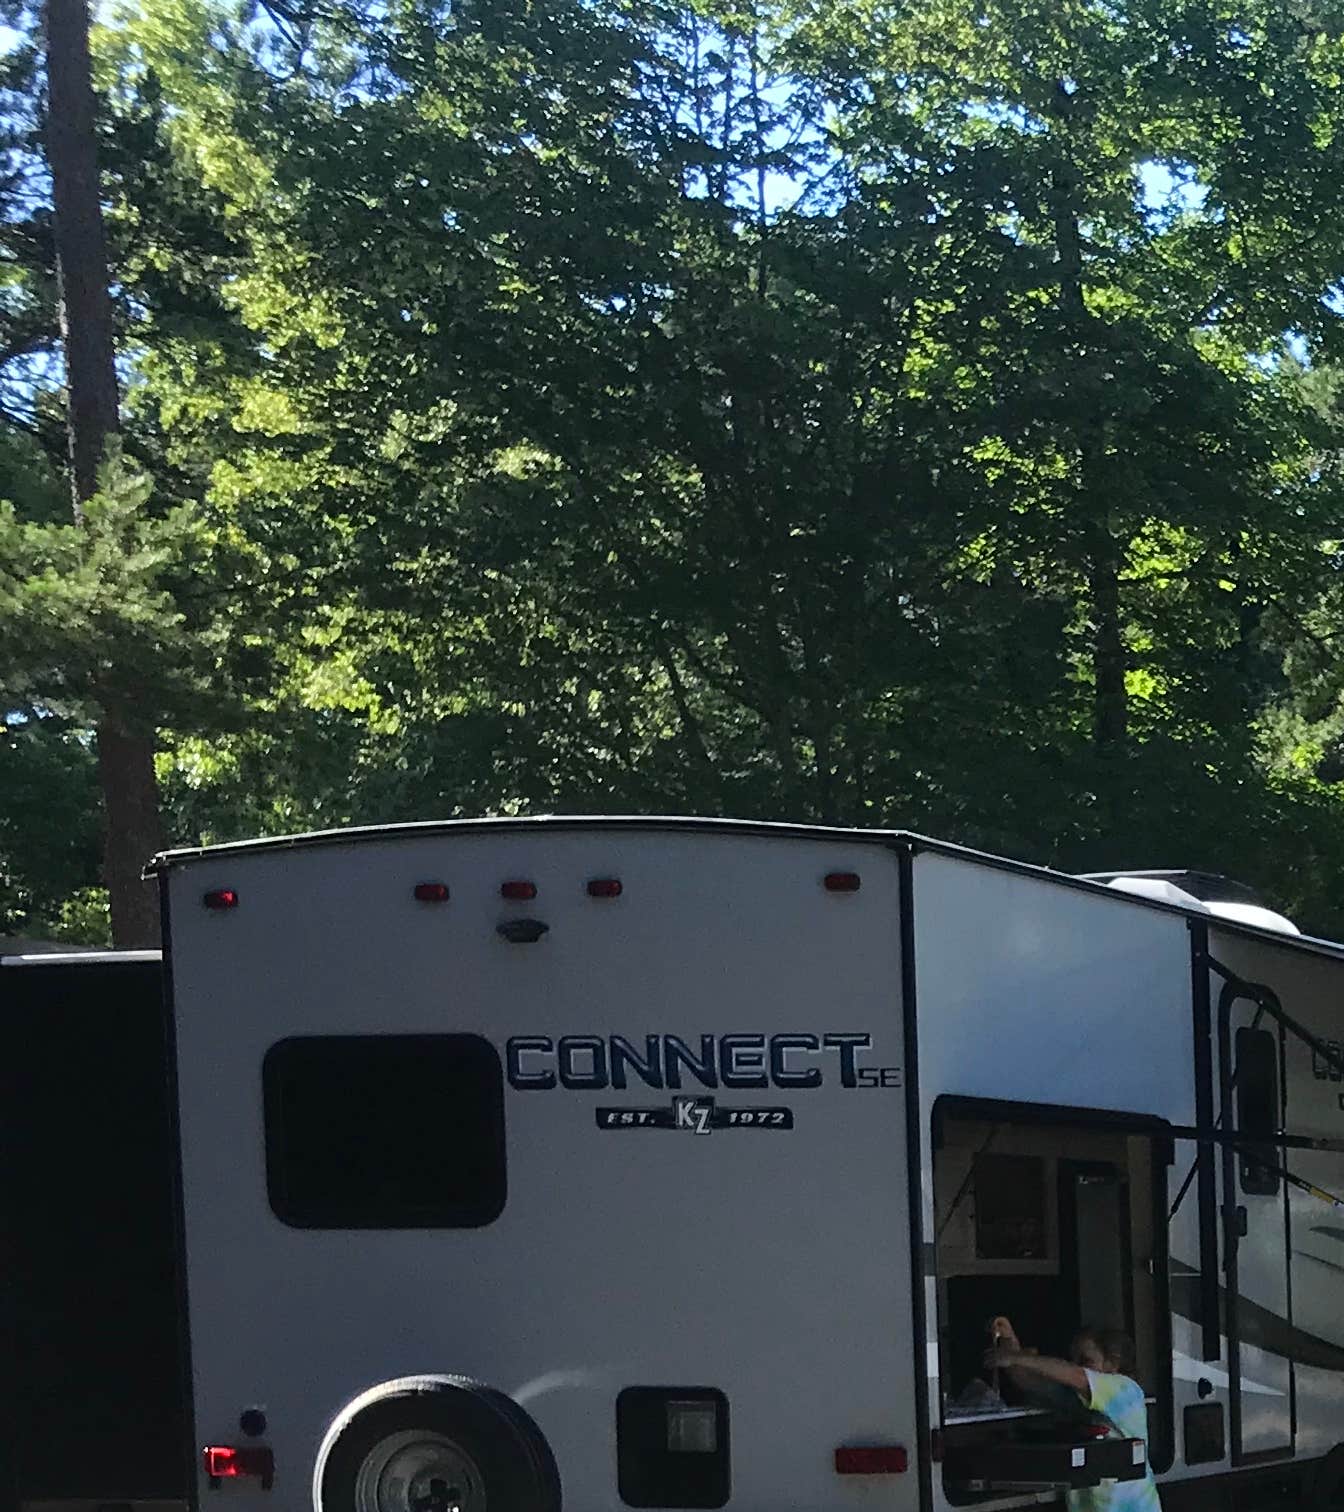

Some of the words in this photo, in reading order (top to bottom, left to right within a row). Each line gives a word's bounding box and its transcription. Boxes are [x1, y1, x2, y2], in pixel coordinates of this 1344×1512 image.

[506, 1033, 871, 1089] CONNECT
[858, 1067, 902, 1088] SE
[607, 1112, 655, 1124] EST.
[678, 1102, 710, 1134] KZ
[729, 1112, 785, 1124] 1972
